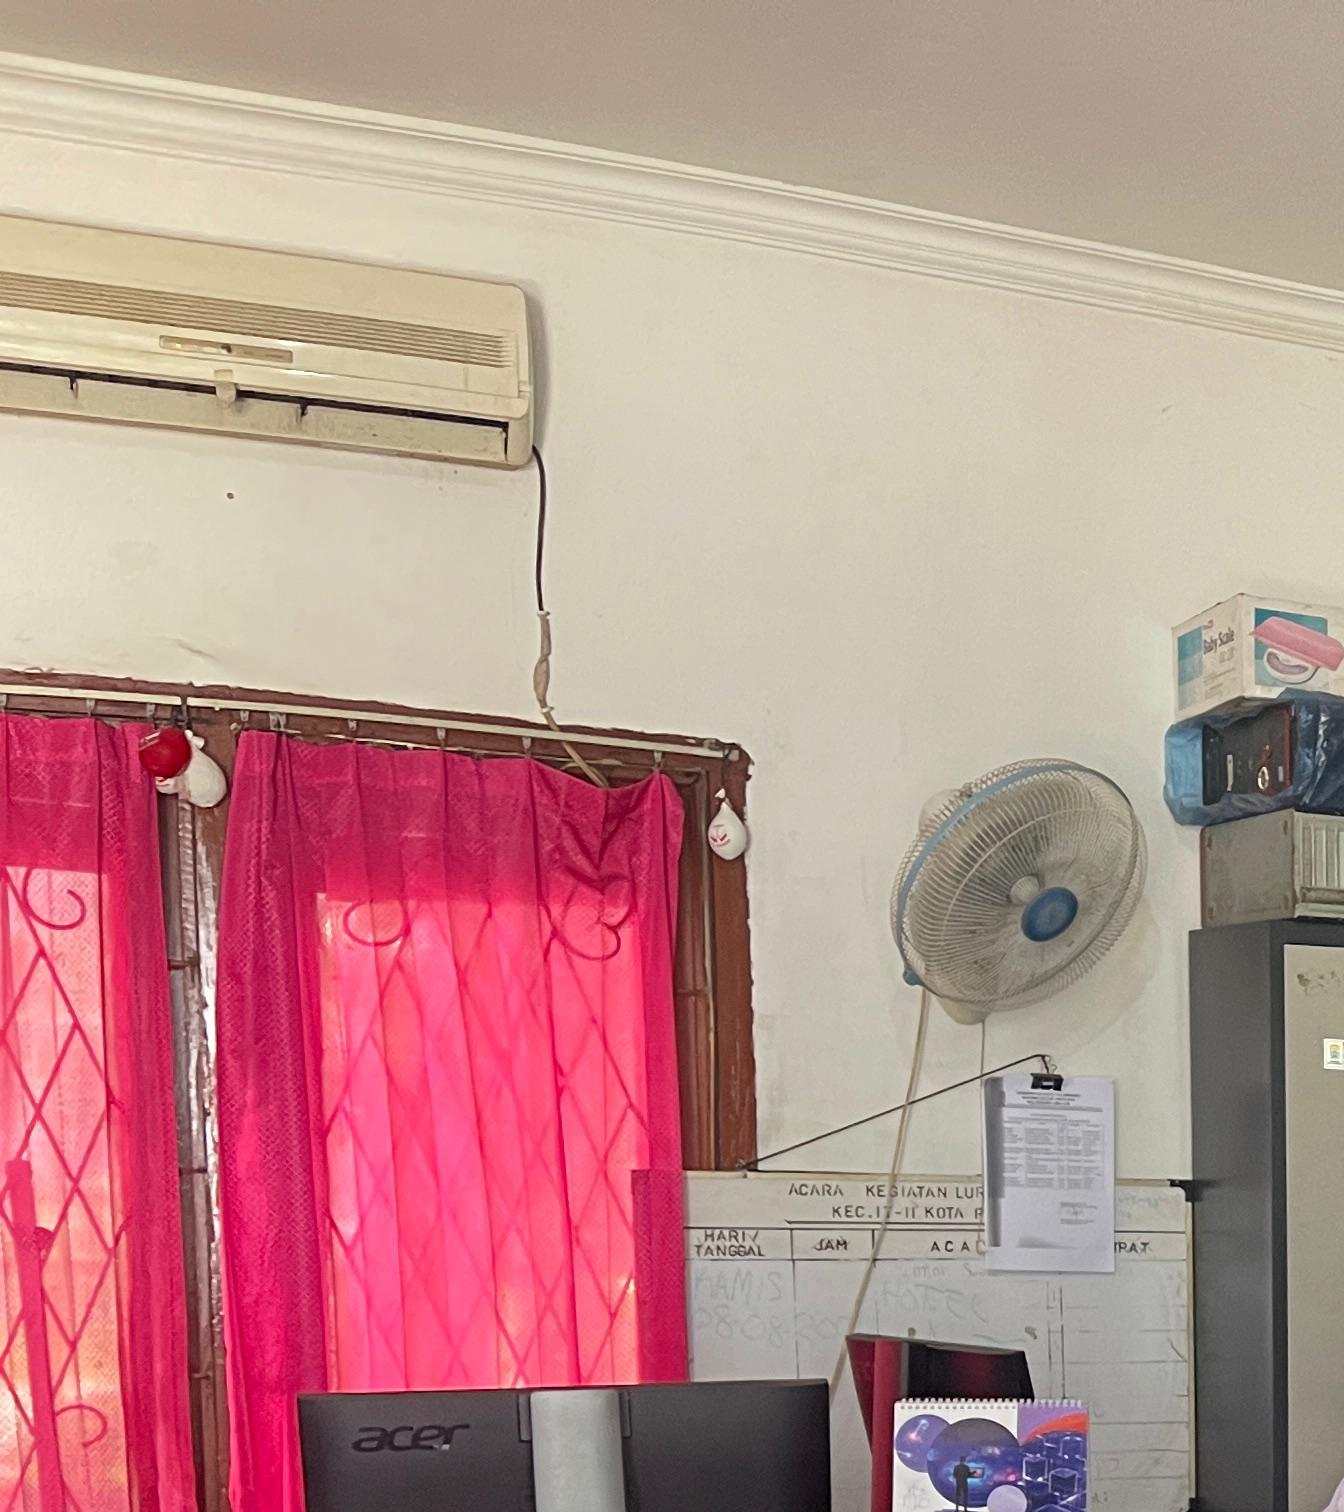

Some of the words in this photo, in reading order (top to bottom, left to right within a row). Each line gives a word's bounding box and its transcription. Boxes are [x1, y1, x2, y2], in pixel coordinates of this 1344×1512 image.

[788, 1183, 845, 1197] ACARA
[865, 1184, 948, 1199] KEGIATAN
[924, 1206, 964, 1220] KOTA
[814, 1237, 849, 1251] JAM
[351, 1423, 470, 1453] acer
